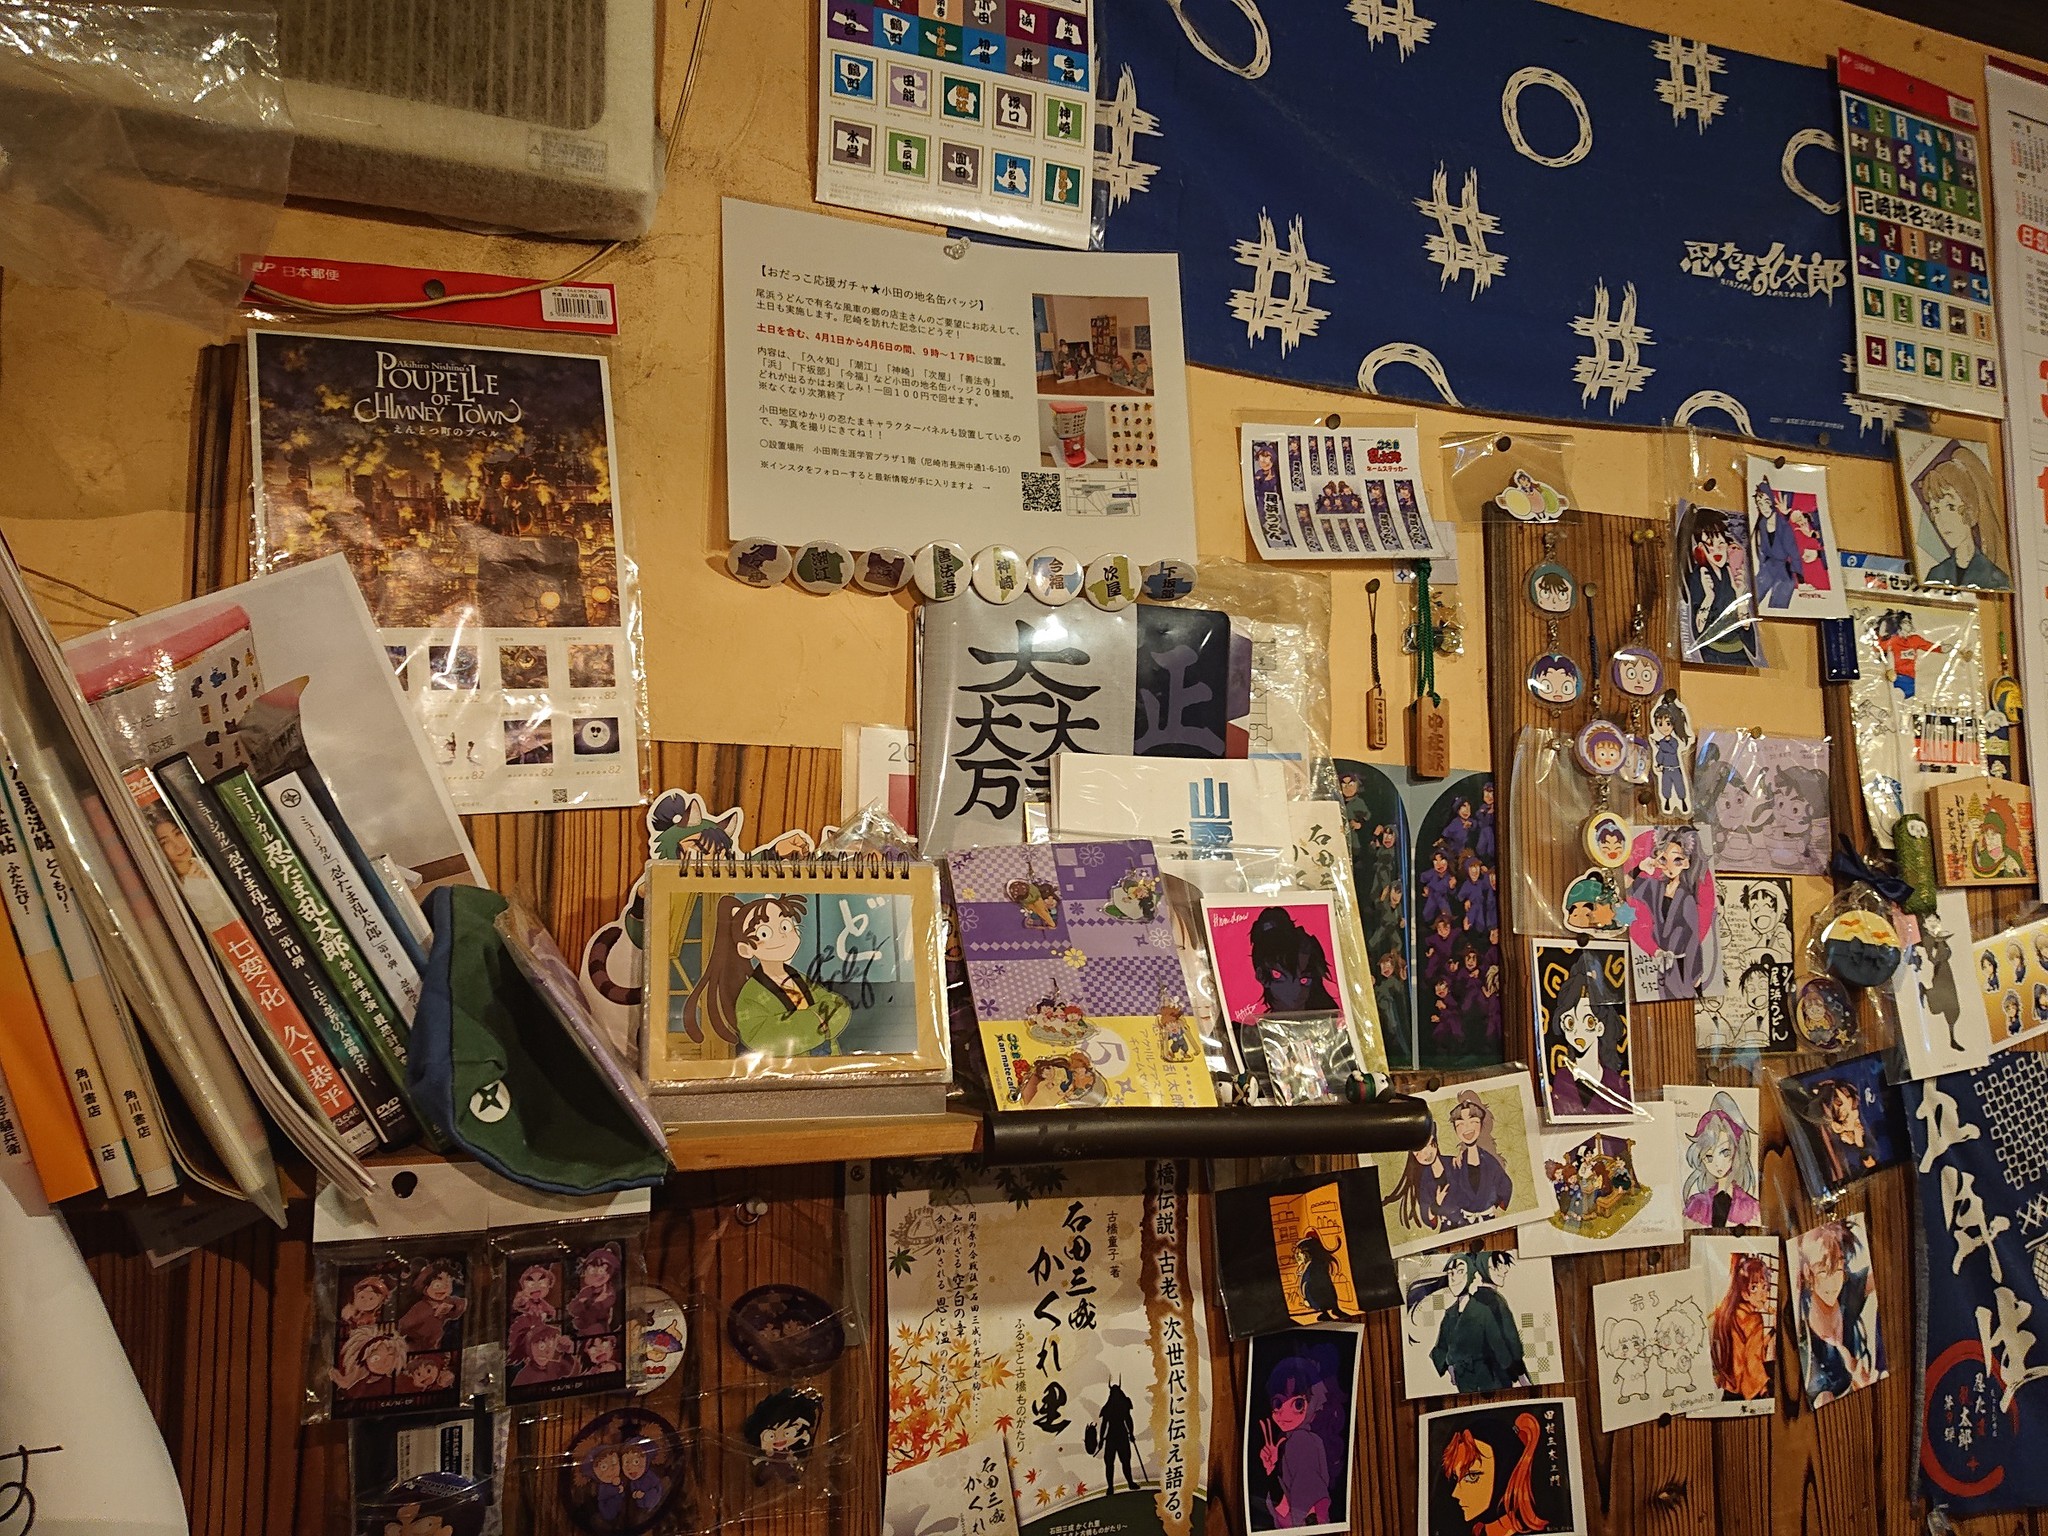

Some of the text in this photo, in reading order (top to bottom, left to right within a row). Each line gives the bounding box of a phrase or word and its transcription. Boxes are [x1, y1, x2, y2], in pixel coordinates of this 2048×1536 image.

[1022, 15, 1033, 27] 浜
[903, 75, 915, 103] 田能
[1008, 95, 1020, 122] 塚口
[846, 130, 860, 160] 水堂
[902, 139, 912, 171] 三反田
[282, 264, 341, 282] 日本郵便
[1679, 240, 1849, 308] 忍たま乱太郎
[375, 350, 500, 403] POUPELLE
[397, 360, 471, 374] Akihiro Nishino's
[431, 392, 452, 407] OF
[758, 381, 845, 401] ※なくなり次第終了
[353, 391, 522, 426] CHIMNEY TOWN
[392, 425, 500, 439] えんとつ町のプペル
[811, 551, 831, 582] 潮江
[937, 548, 957, 596] 善法寺
[995, 559, 1015, 591] 神崎
[1049, 558, 1065, 590] 今福
[1103, 565, 1122, 598] 次屋
[1161, 566, 1178, 599] 下坂部
[471, 771, 486, 780] 82
[541, 768, 554, 777] 82
[608, 766, 622, 774] 82
[7, 862, 30, 916] ふたたび!
[46, 858, 70, 914] とくもり!
[233, 786, 275, 843] ミュージカル
[263, 839, 351, 962] 忍たま乱太郎
[283, 1024, 346, 1109] 久下恭平
[74, 1067, 101, 1118] 角川書店
[375, 1096, 400, 1115] DVD
[123, 1089, 151, 1139] 角川書店
[1105, 1210, 1120, 1278] 古橋童子 著
[1061, 1200, 1098, 1330] 石田三成
[1026, 1245, 1072, 1437] かくれ里
[1014, 1318, 1028, 1453] ふるさと古橋ものがたり
[981, 1456, 1007, 1525] 石田三成
[1049, 1519, 1101, 1535] 石田三成 かくれ里
